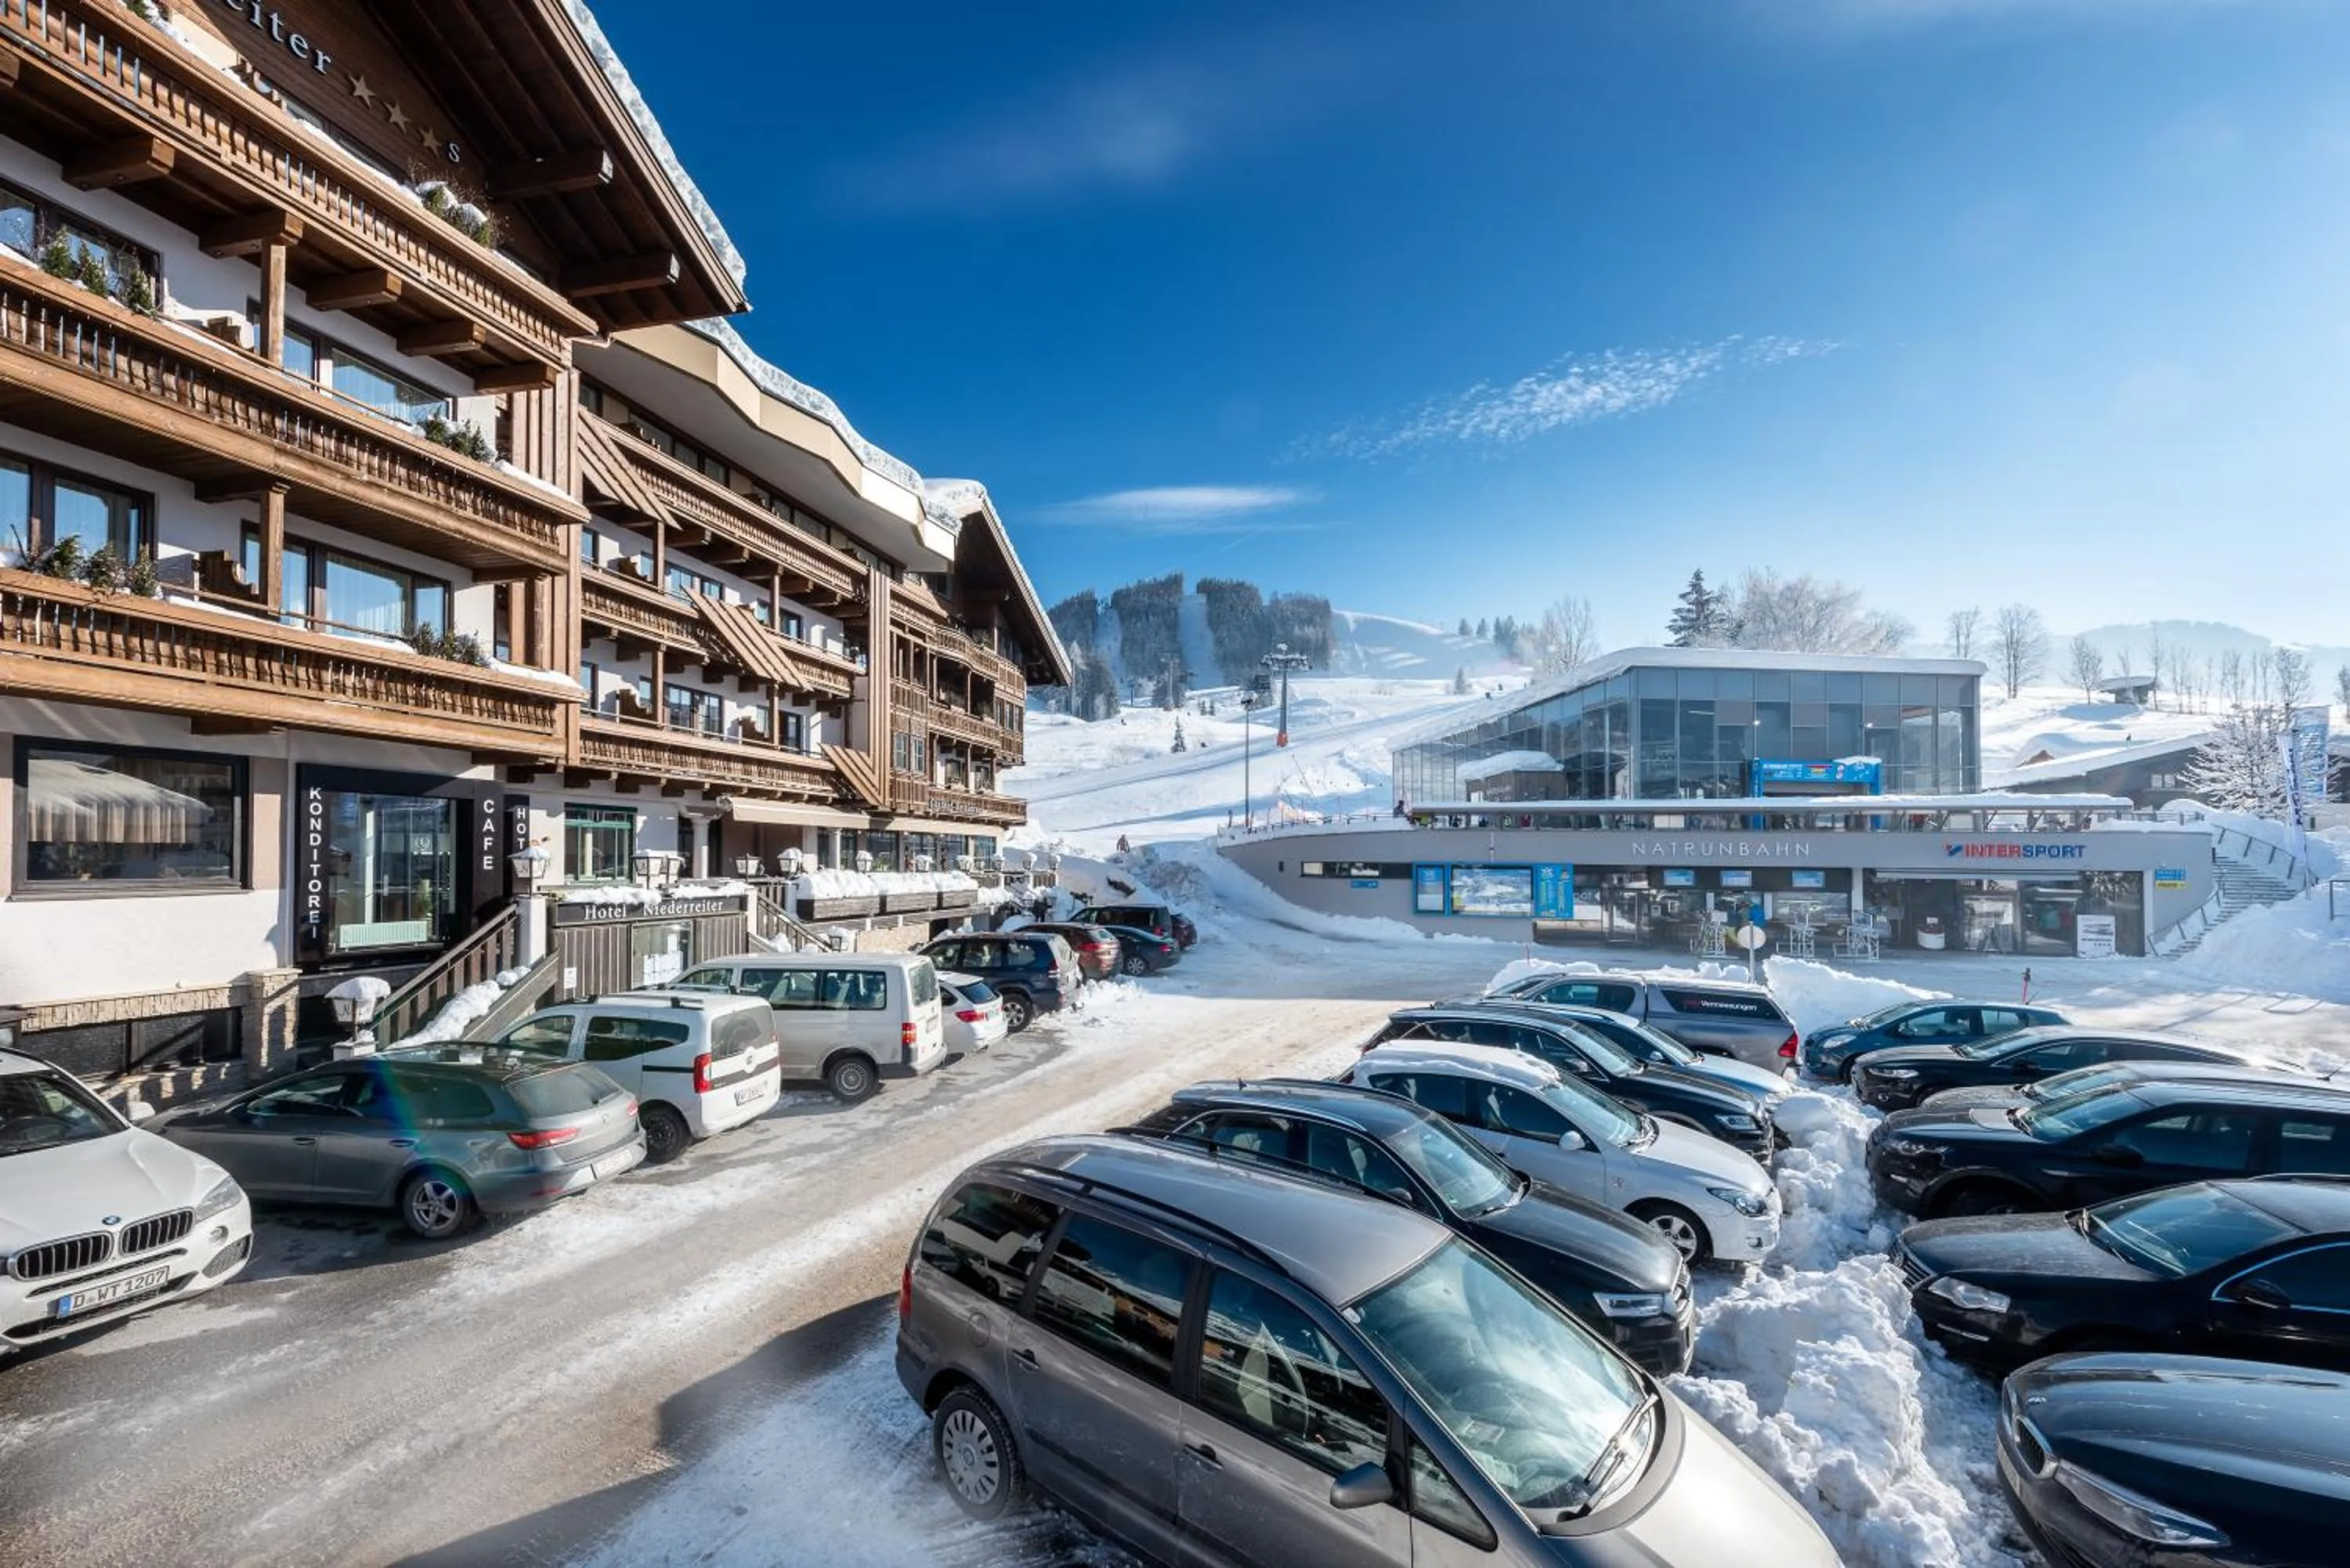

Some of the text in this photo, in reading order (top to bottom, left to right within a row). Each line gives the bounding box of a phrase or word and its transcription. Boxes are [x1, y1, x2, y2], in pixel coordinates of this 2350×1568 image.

[483, 800, 495, 870] CAFE
[516, 807, 526, 850] HOT
[1632, 842, 1810, 857] NATRUNBAHN
[1965, 844, 2087, 858] INTERSPORT
[308, 786, 323, 939] KONDITOREI
[584, 900, 723, 920] Hotel Niederreiter
[125, 1270, 164, 1292] 1207
